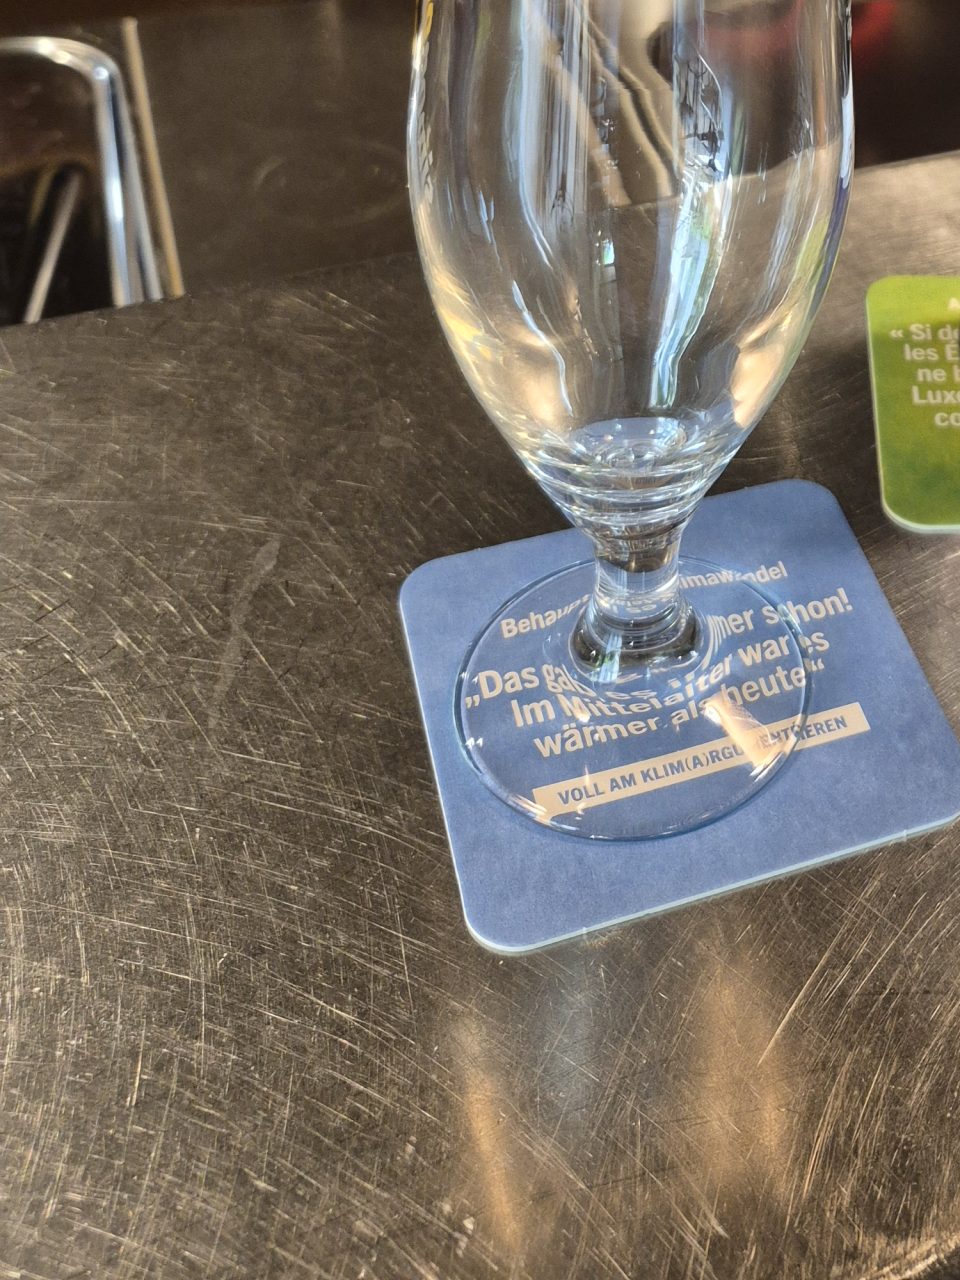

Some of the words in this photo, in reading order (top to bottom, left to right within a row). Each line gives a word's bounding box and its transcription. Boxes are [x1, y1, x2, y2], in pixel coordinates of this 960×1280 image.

[909, 323, 932, 341] Si
[904, 344, 939, 361] les
[917, 368, 946, 382] ne
[501, 594, 590, 638] Behaup
[465, 666, 540, 708] „Das
[511, 696, 556, 728] Im
[737, 634, 790, 667] war
[534, 716, 661, 758] wärmer
[557, 783, 605, 806] VOLL
[609, 774, 637, 793] AM
